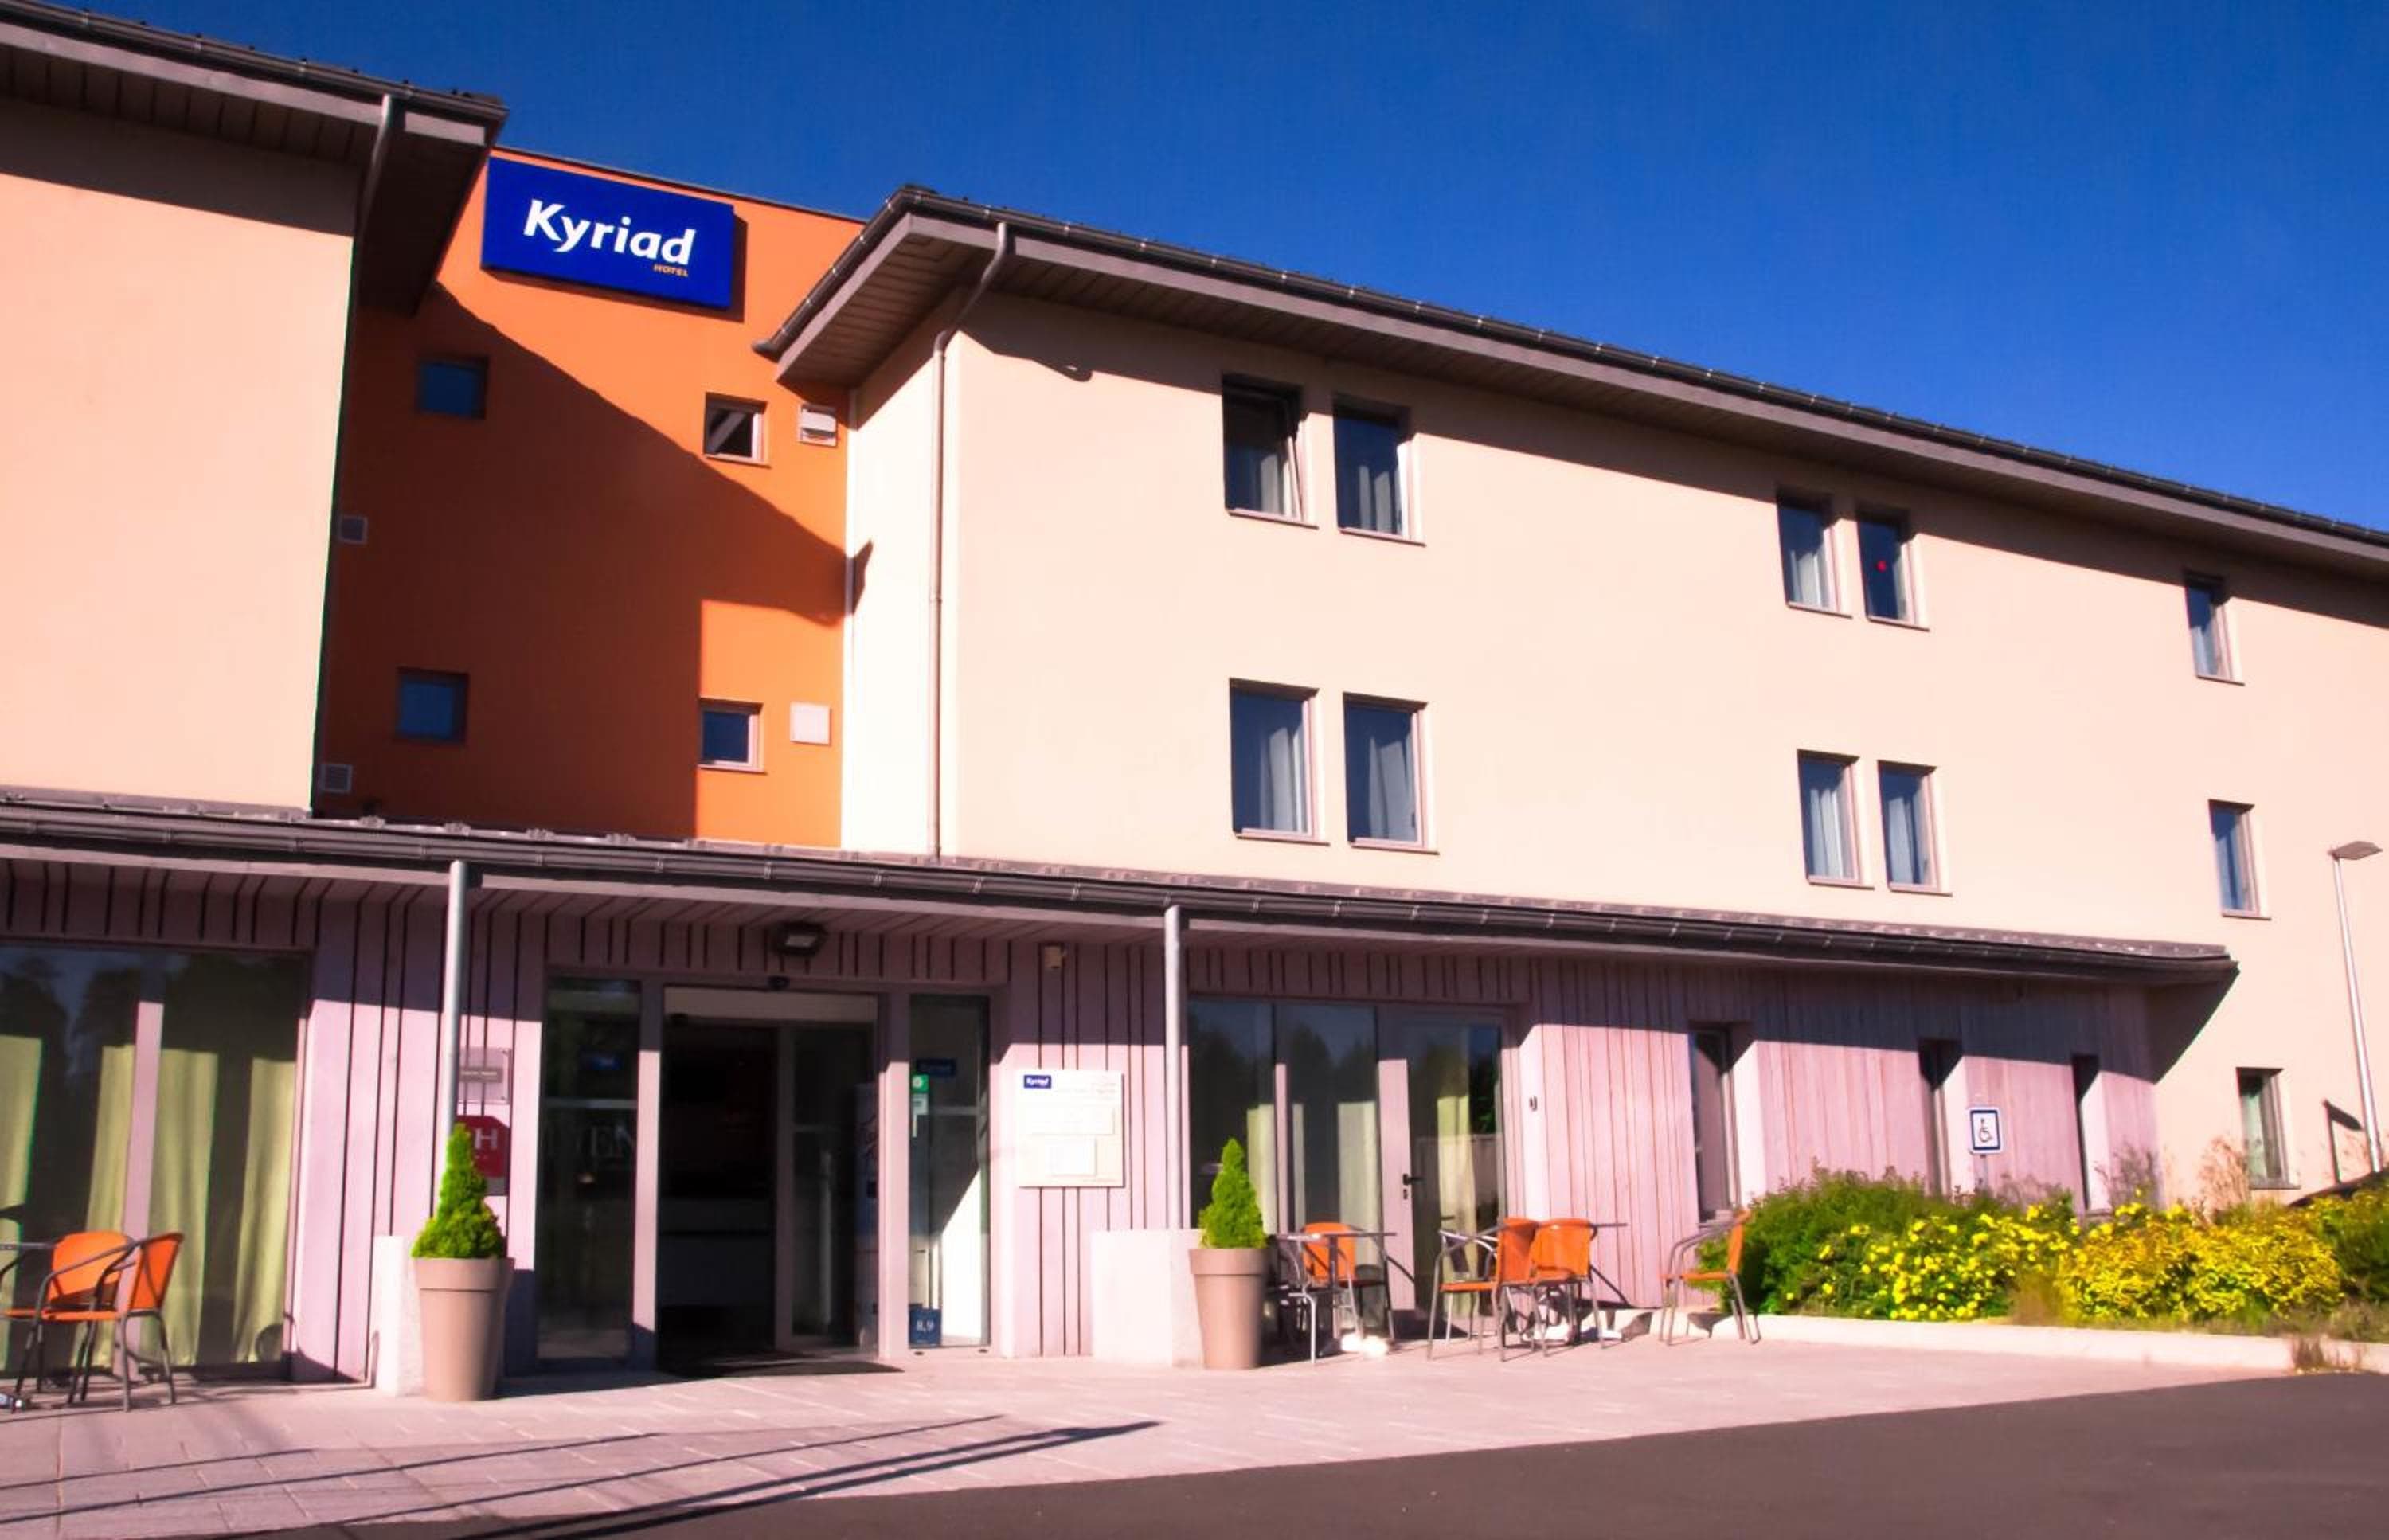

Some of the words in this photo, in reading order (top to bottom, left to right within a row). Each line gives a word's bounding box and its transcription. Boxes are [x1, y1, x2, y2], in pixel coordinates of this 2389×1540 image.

[523, 199, 697, 266] Kyriad
[653, 264, 689, 277] HOTEL
[475, 1128, 498, 1150] H
